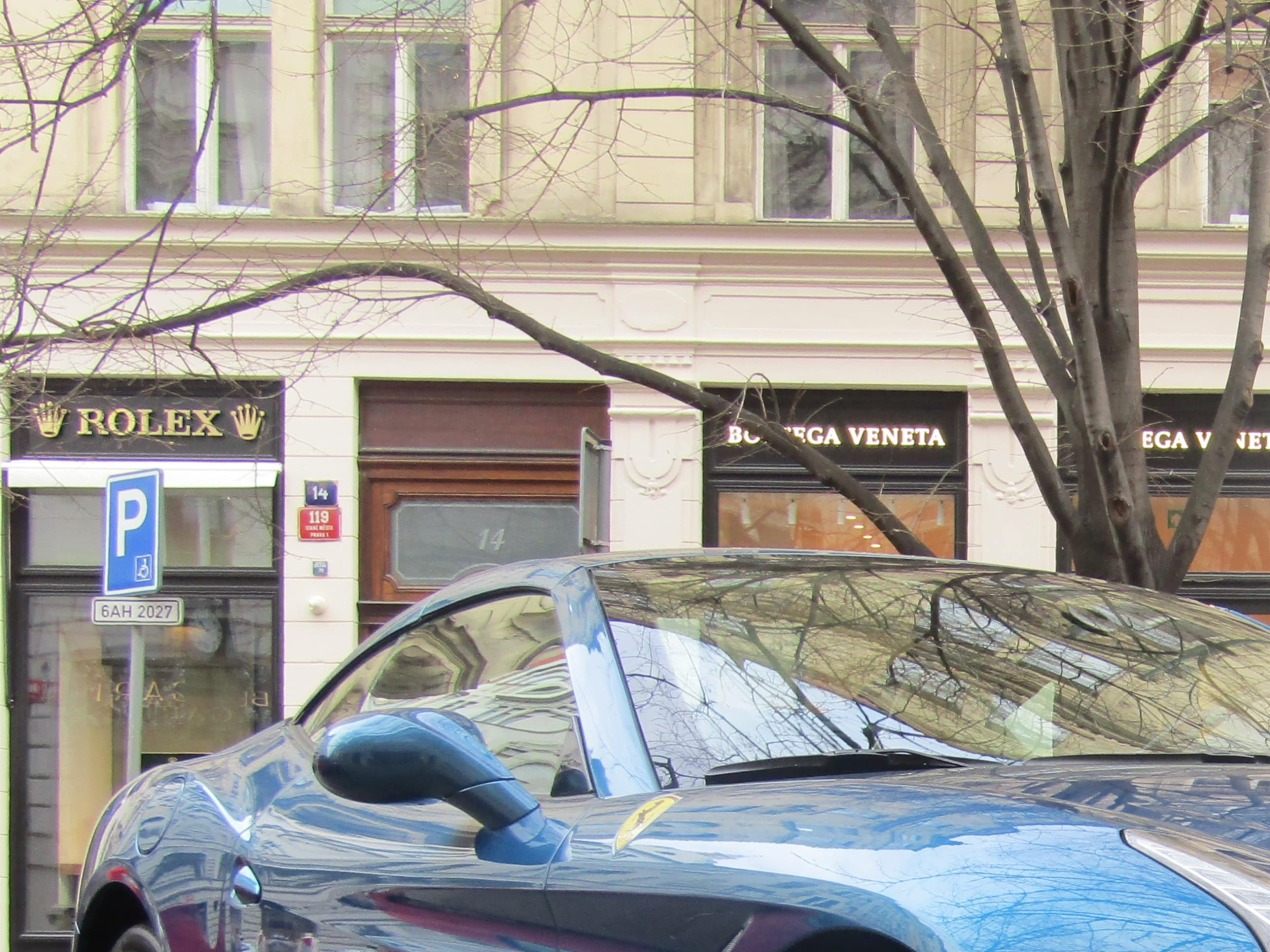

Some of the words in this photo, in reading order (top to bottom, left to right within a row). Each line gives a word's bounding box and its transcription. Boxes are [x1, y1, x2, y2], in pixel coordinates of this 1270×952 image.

[76, 408, 224, 437] ROLEX
[727, 425, 842, 445] BOEGA
[848, 427, 945, 446] VENETA
[312, 485, 329, 501] 14
[116, 488, 148, 557] P
[309, 510, 330, 524] 119
[479, 527, 506, 551] 14
[101, 604, 132, 619] 6AH
[137, 604, 174, 619] 2027
